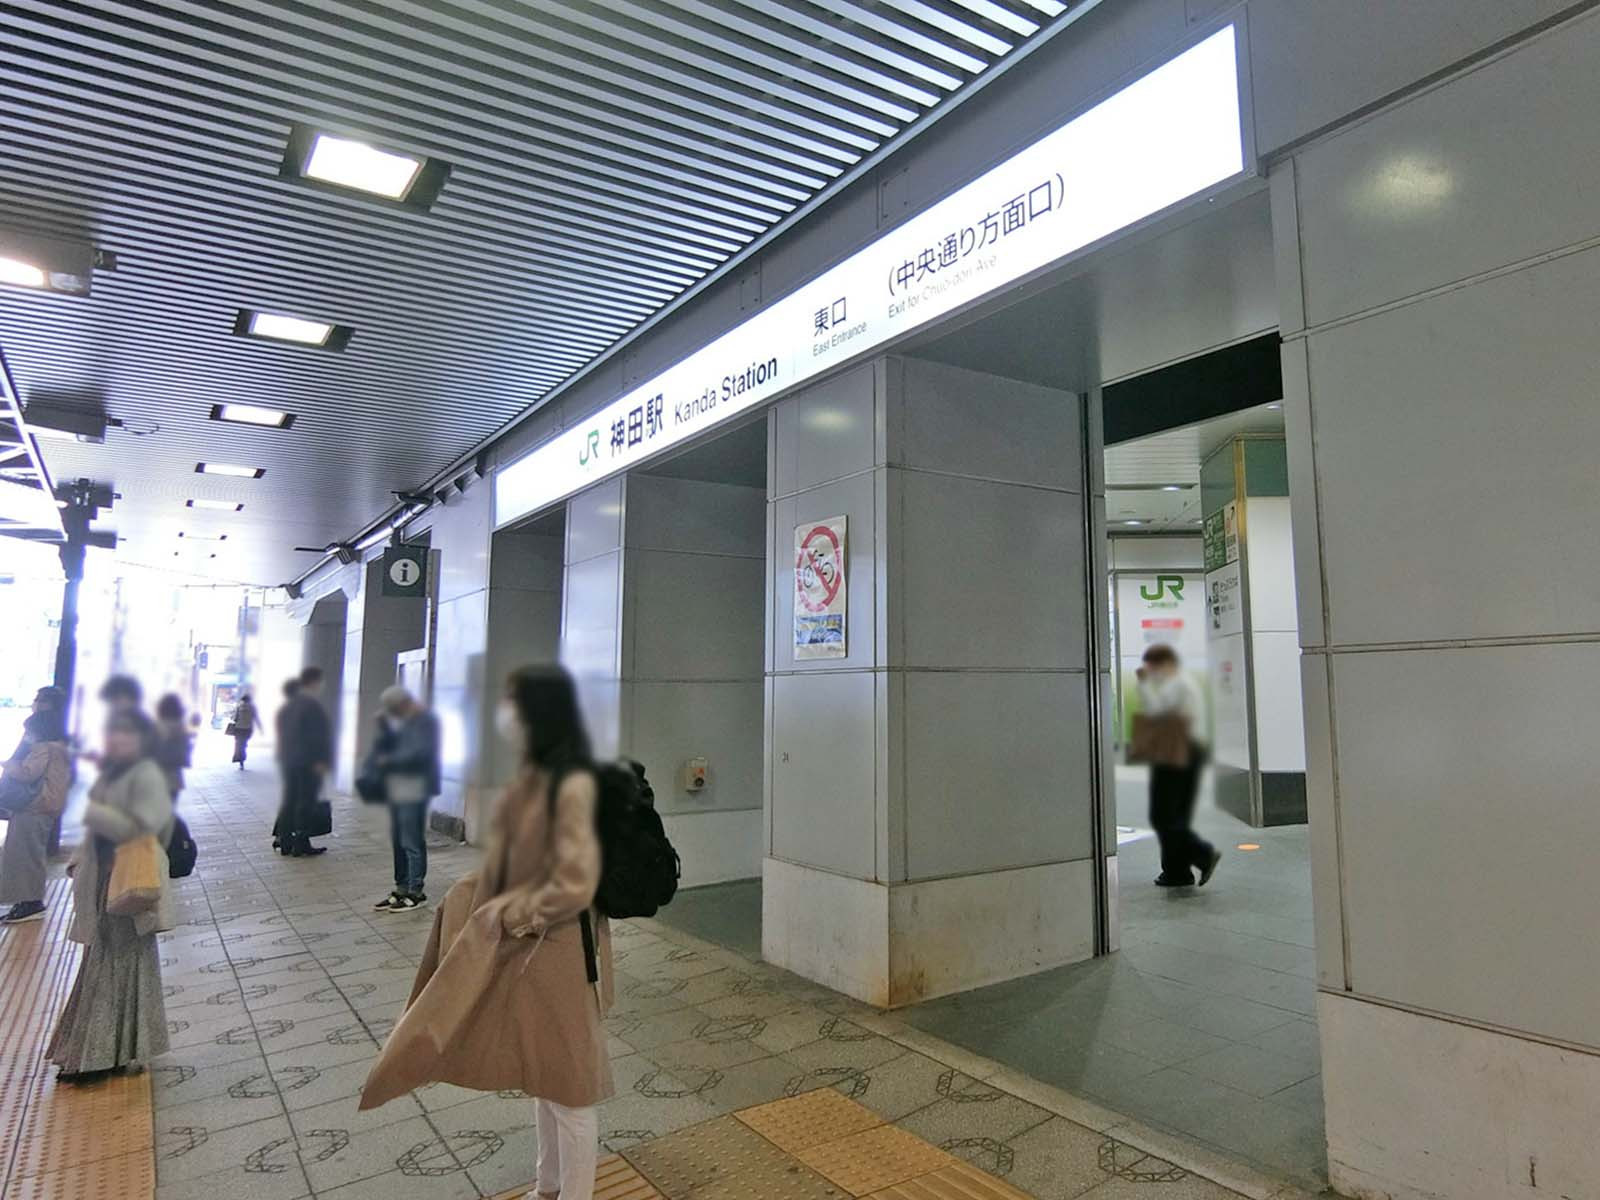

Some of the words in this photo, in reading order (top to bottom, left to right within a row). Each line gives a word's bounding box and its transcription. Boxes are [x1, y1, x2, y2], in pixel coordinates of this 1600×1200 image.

[889, 173, 1064, 296] (中央通り方面口)
[814, 296, 847, 337] 東口
[888, 300, 906, 319] Exit
[908, 295, 920, 310] for
[813, 339, 830, 357] East
[831, 321, 867, 347] Entrance
[579, 429, 599, 466] JR
[610, 393, 663, 458] 神田駅
[674, 388, 717, 426] Kanda
[721, 357, 778, 402] Station
[1140, 575, 1184, 601] JR
